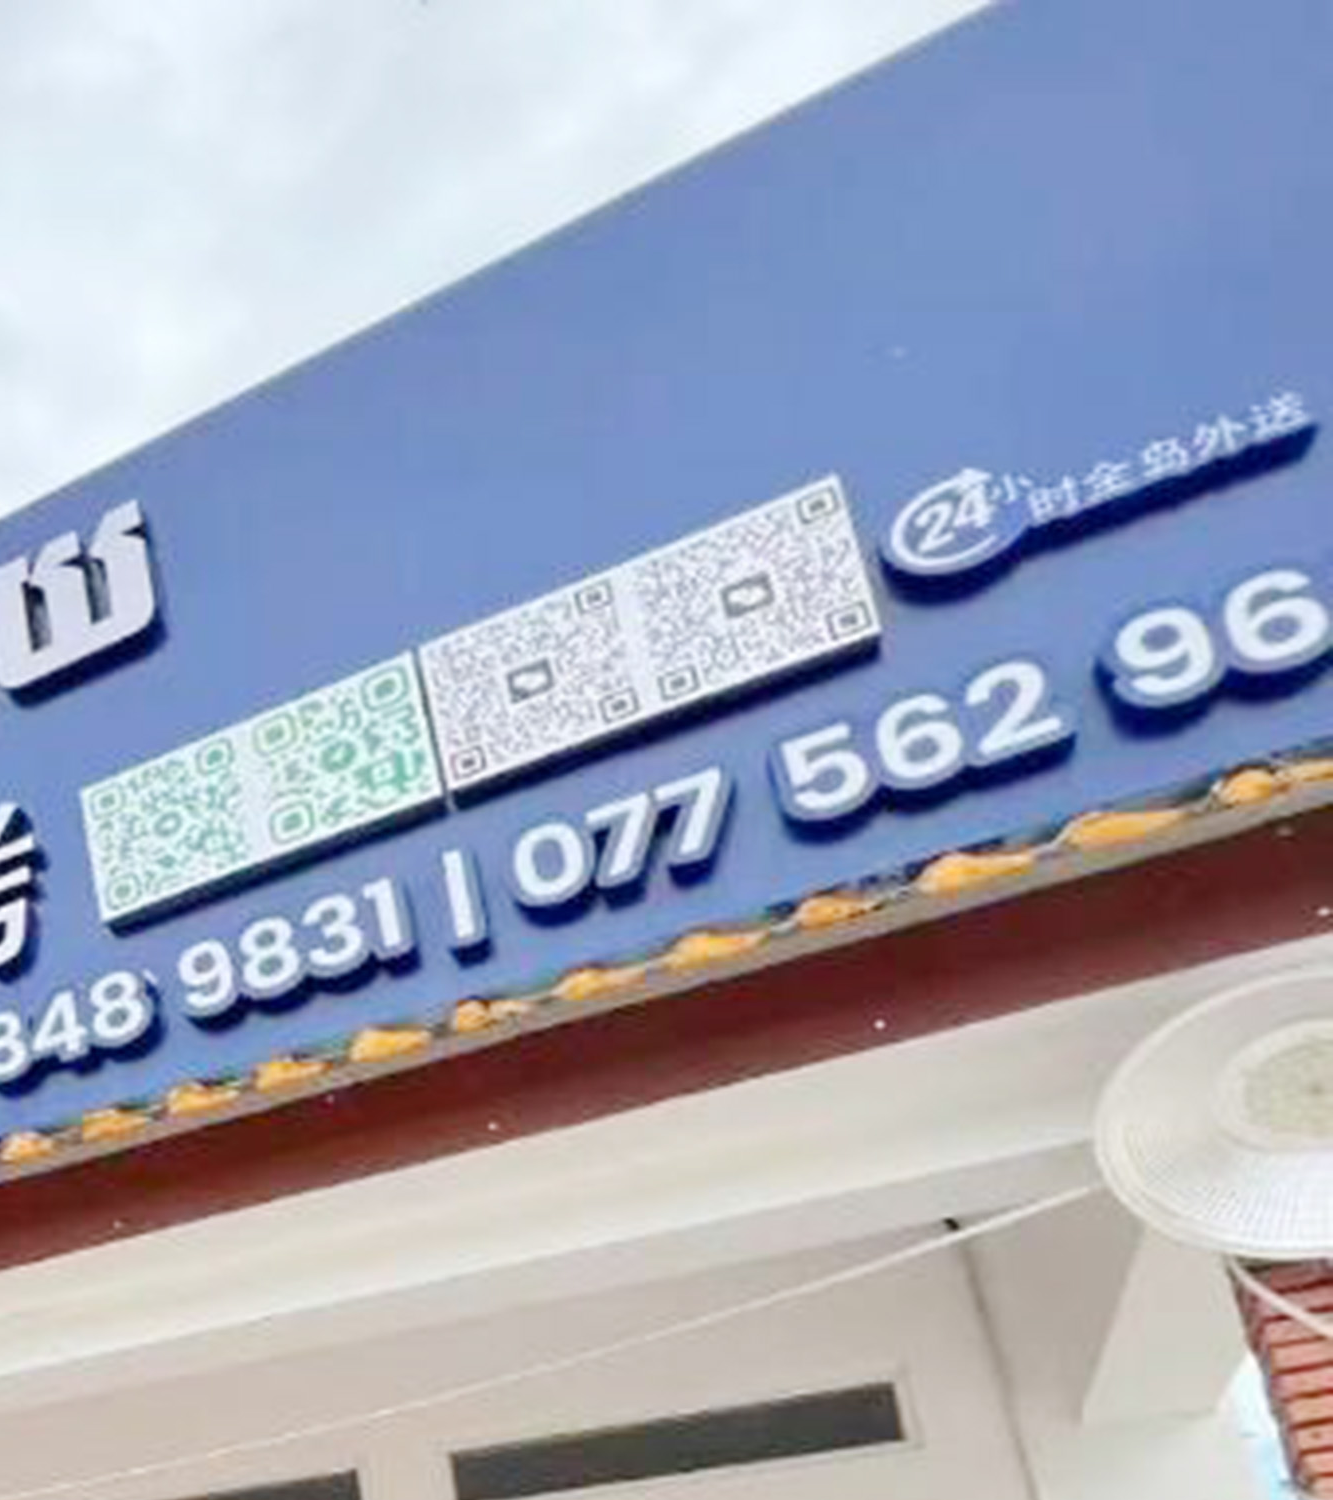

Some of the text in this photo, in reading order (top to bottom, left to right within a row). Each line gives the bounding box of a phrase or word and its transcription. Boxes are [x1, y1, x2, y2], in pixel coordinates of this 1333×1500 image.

[179, 877, 411, 1014] 9831
[513, 765, 731, 910] 077
[778, 660, 1066, 821] 562
[1113, 569, 1333, 709] 96
